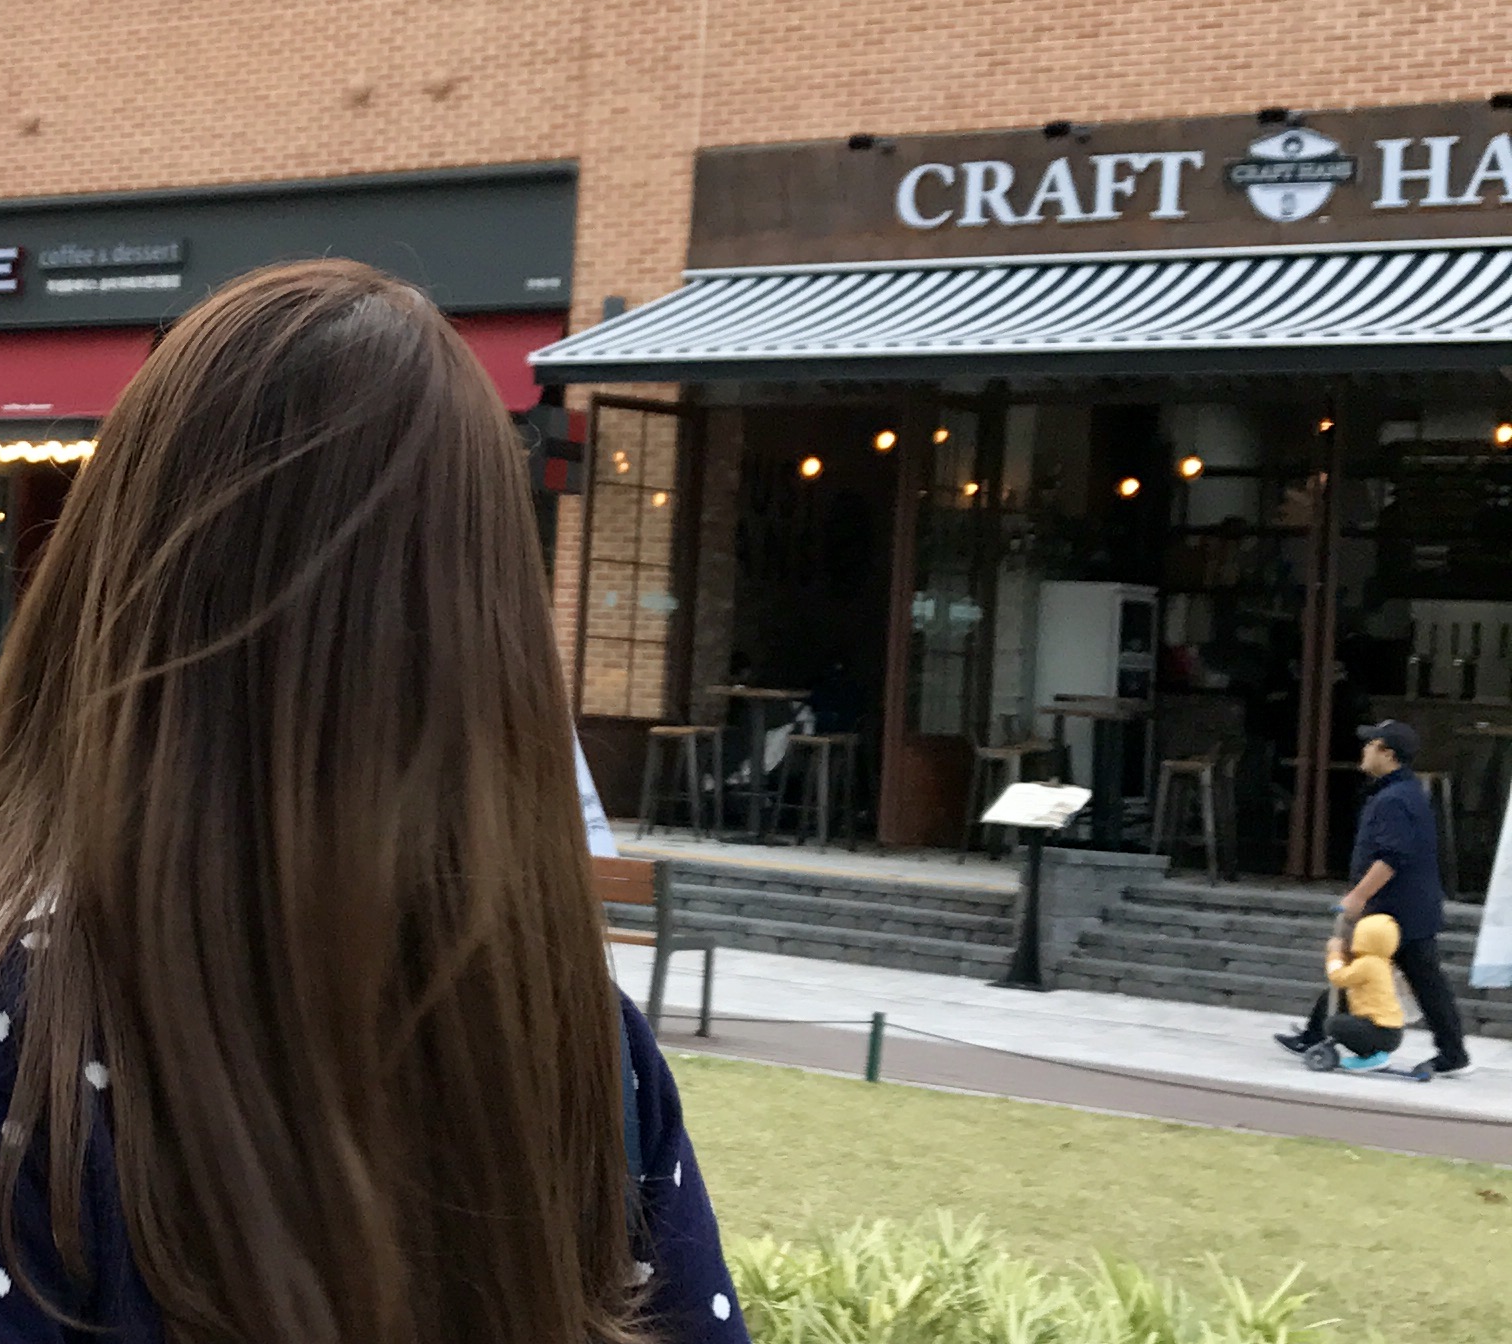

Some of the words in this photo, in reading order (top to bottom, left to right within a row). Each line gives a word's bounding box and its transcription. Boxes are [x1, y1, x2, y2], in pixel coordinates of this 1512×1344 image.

[895, 150, 1205, 230] CRAFT
[1371, 132, 1512, 211] HA
[111, 240, 181, 264] dessert
